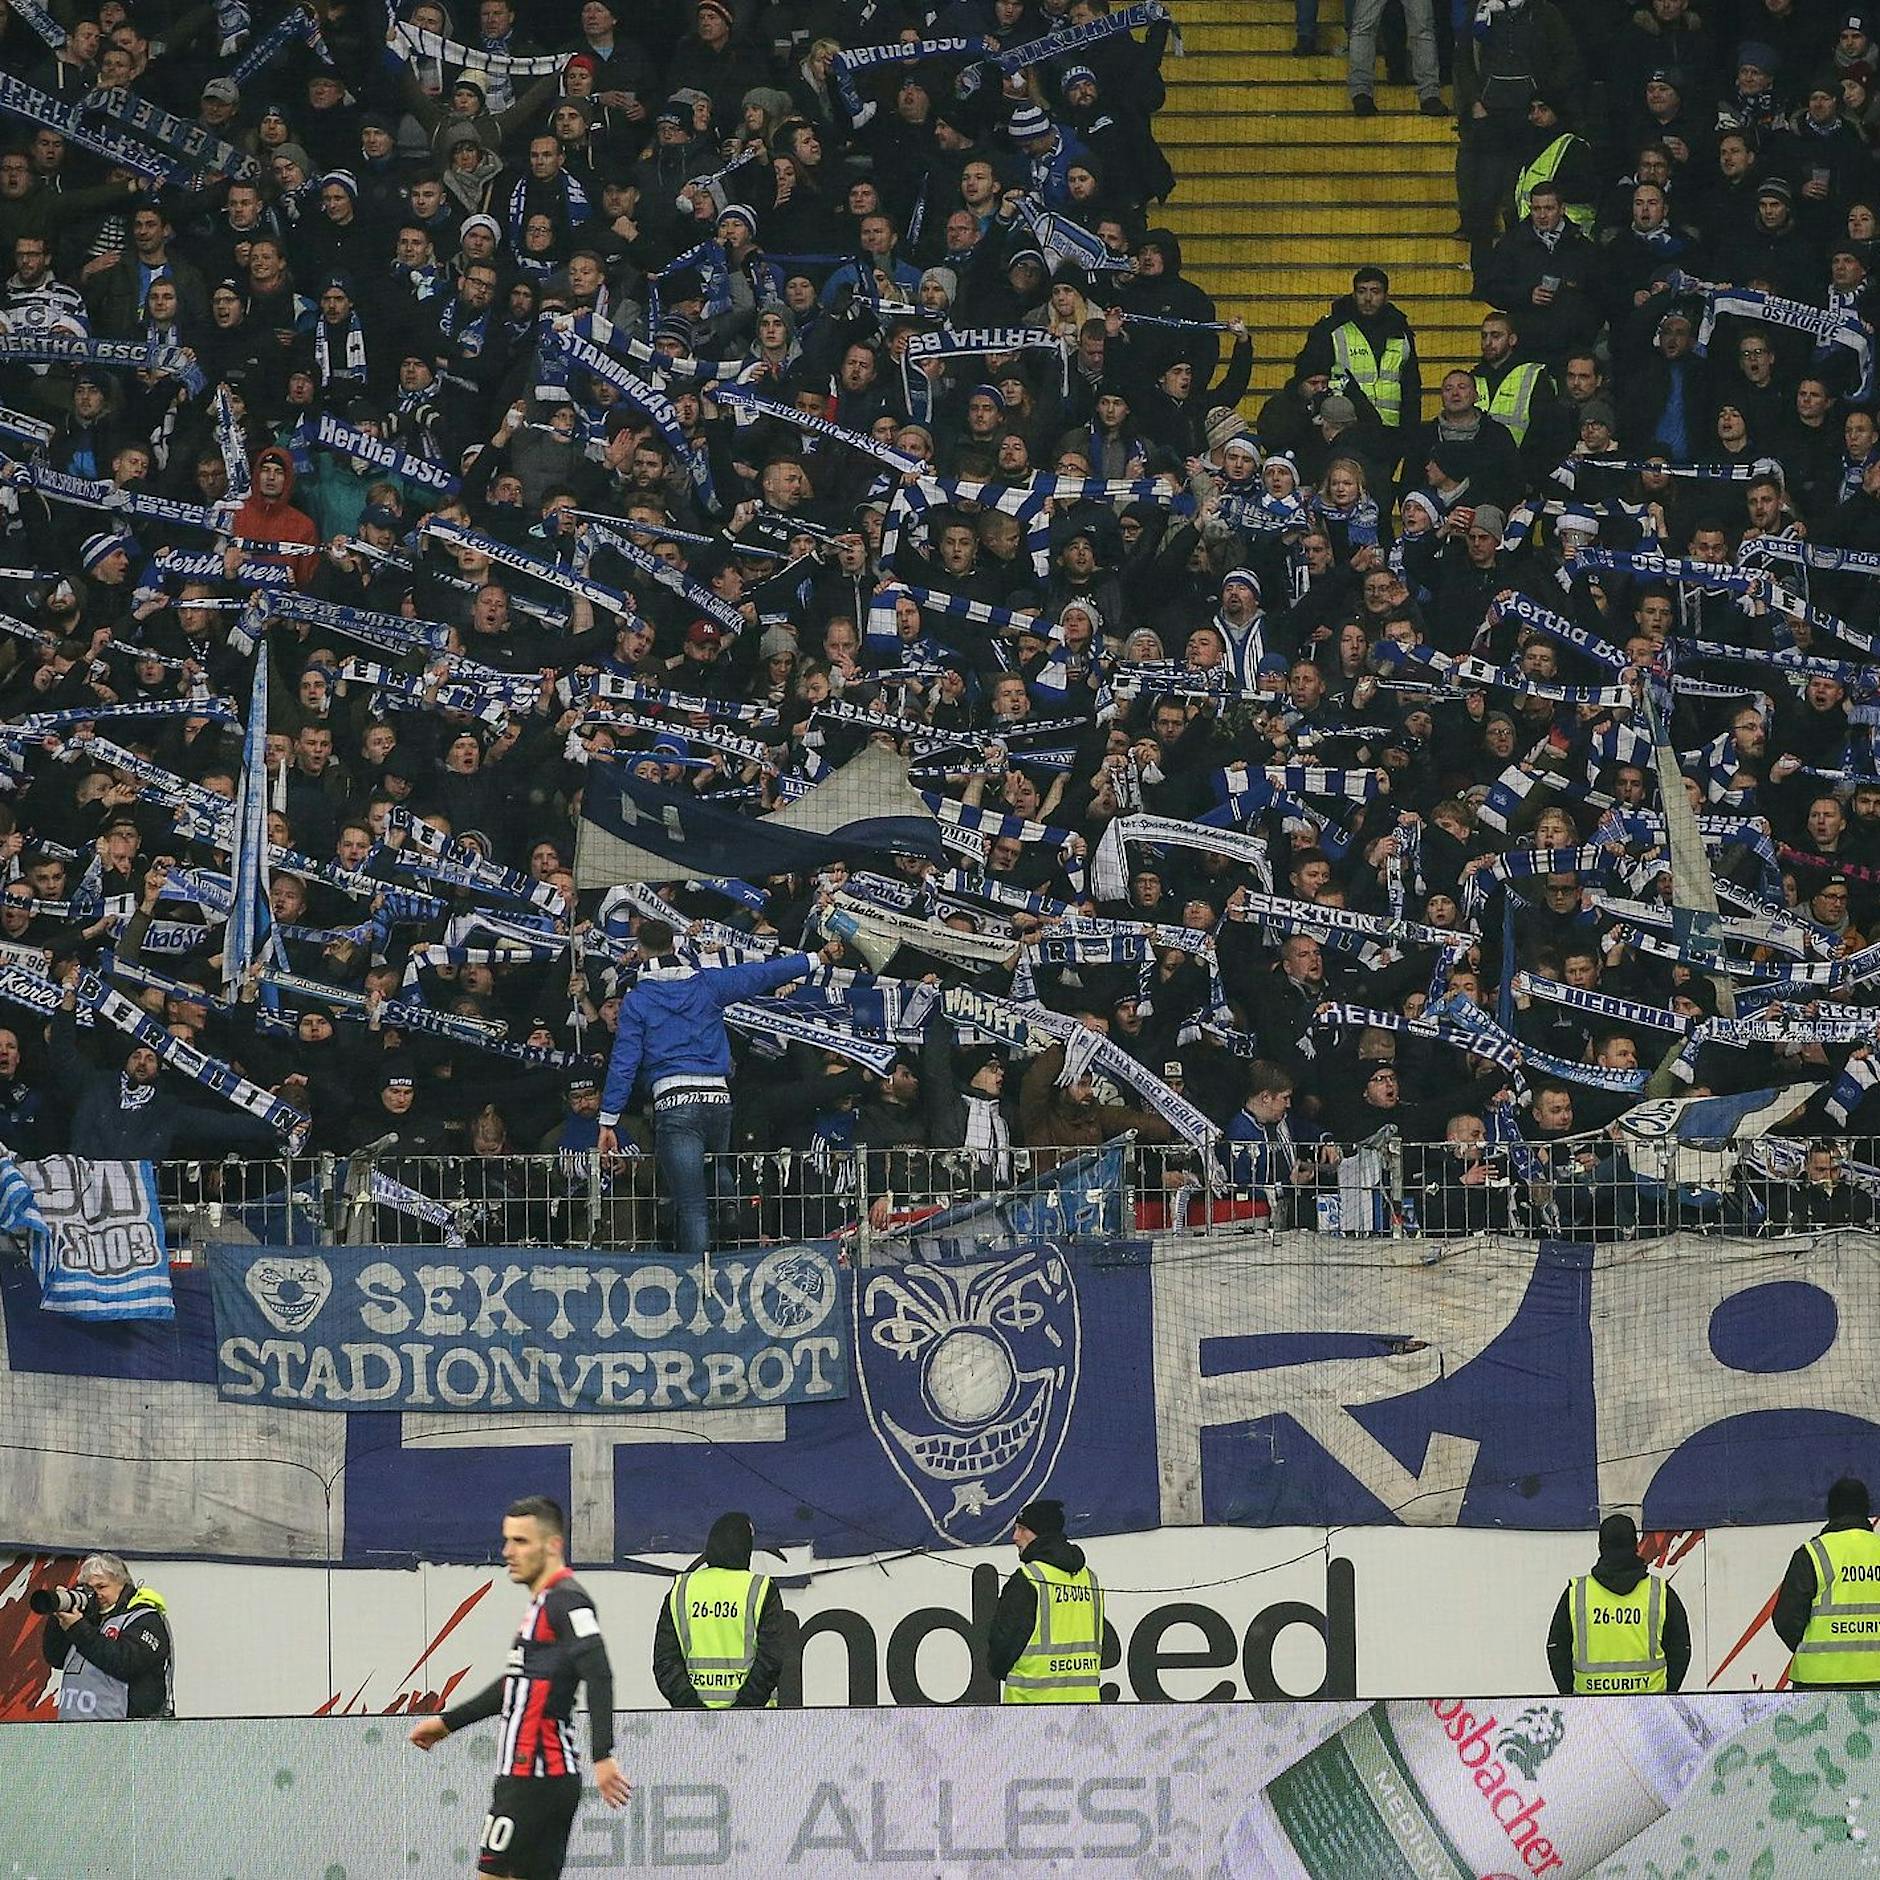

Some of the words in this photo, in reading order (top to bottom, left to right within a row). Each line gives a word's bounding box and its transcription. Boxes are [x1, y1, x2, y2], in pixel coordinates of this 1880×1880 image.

[1759, 305, 1840, 339] OSTKURVE
[95, 342, 148, 361] BSC
[907, 332, 943, 353] BS
[557, 330, 683, 432] STAMMGAST
[319, 415, 396, 466] Hertha
[400, 454, 453, 490] BSC
[134, 500, 204, 524] BSC
[1592, 639, 1632, 668] BS
[1246, 891, 1379, 933] SEKTION
[1566, 988, 1677, 1028] HERTHA
[1819, 1003, 1880, 1022] GEGE
[1131, 1071, 1166, 1101] BSC
[1157, 1093, 1209, 1137] BERLIN
[355, 1262, 752, 1338] SEKTION
[219, 1336, 841, 1411] STADIONVERBOT
[692, 1601, 738, 1618] 26-036
[1593, 1607, 1641, 1625] 26-020
[779, 1557, 1357, 1705] nded
[688, 1672, 745, 1686] SECURITY
[1050, 1658, 1098, 1671] SECURIT
[1586, 1676, 1650, 1691] SECURITY
[60, 1688, 97, 1714] TO
[1428, 1699, 1563, 1878] osbacher
[560, 1784, 731, 1868] GIB
[786, 1777, 1171, 1867] ALLES!
